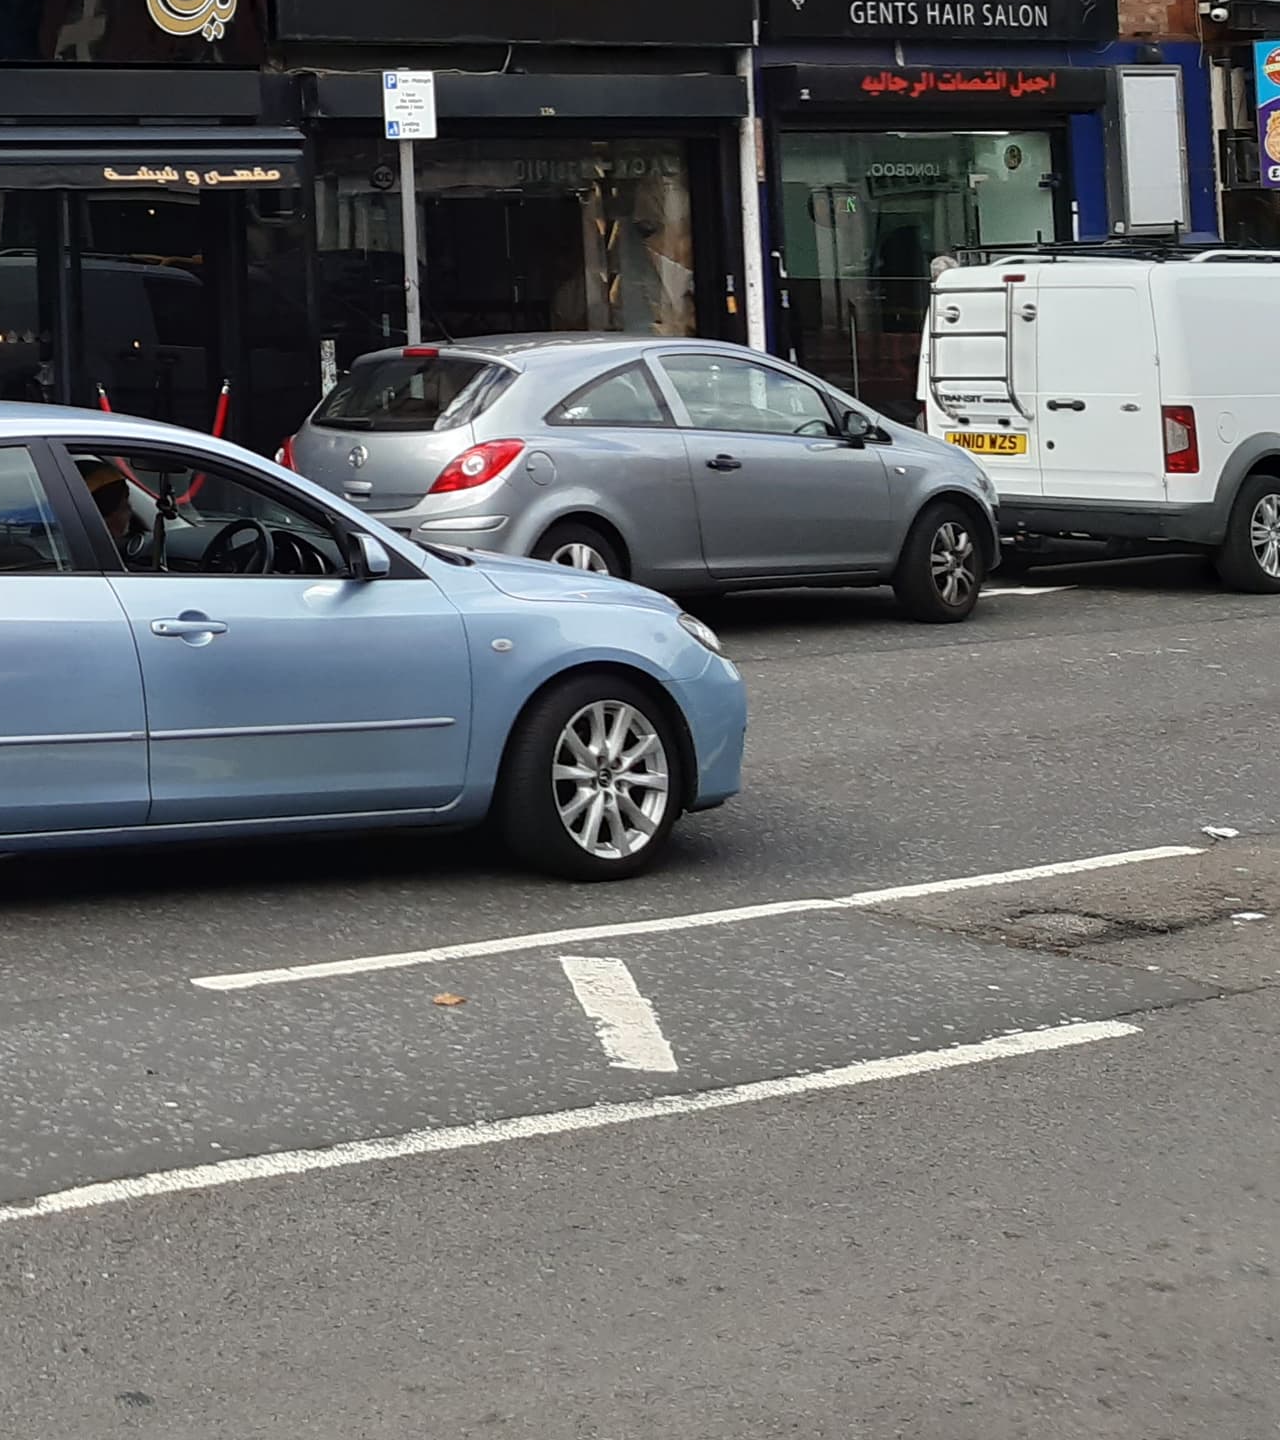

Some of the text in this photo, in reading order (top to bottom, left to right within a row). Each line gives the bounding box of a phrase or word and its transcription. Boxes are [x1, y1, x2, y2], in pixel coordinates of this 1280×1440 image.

[850, 0, 1049, 28] GENTS HAIR SALON
[185, 168, 201, 186] و
[940, 394, 982, 403] TRANSIT
[952, 433, 1018, 450] HN10 WZS
